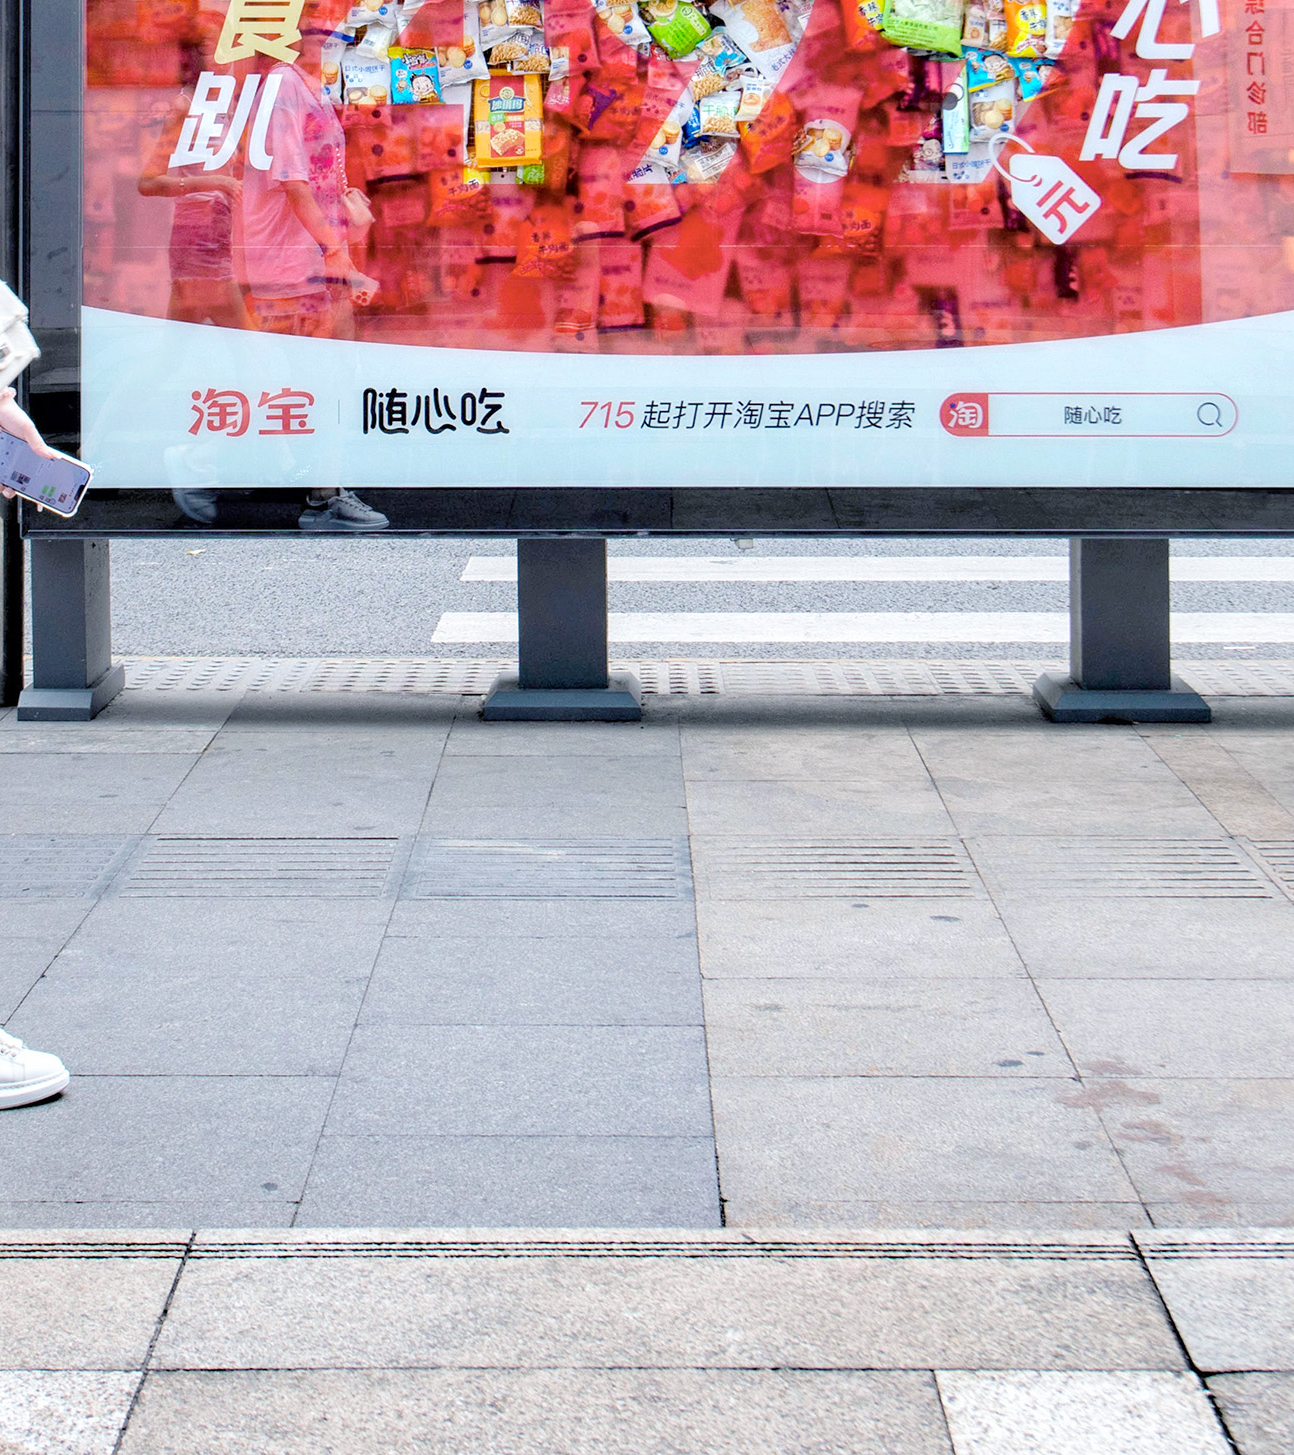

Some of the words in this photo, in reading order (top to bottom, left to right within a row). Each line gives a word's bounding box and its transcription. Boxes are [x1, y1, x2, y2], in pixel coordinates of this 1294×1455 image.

[1036, 181, 1090, 234] 元
[188, 388, 316, 437] 淘宝
[362, 387, 510, 436] 随心吃
[948, 402, 984, 430] 淘
[1063, 405, 1123, 426] 随心吃
